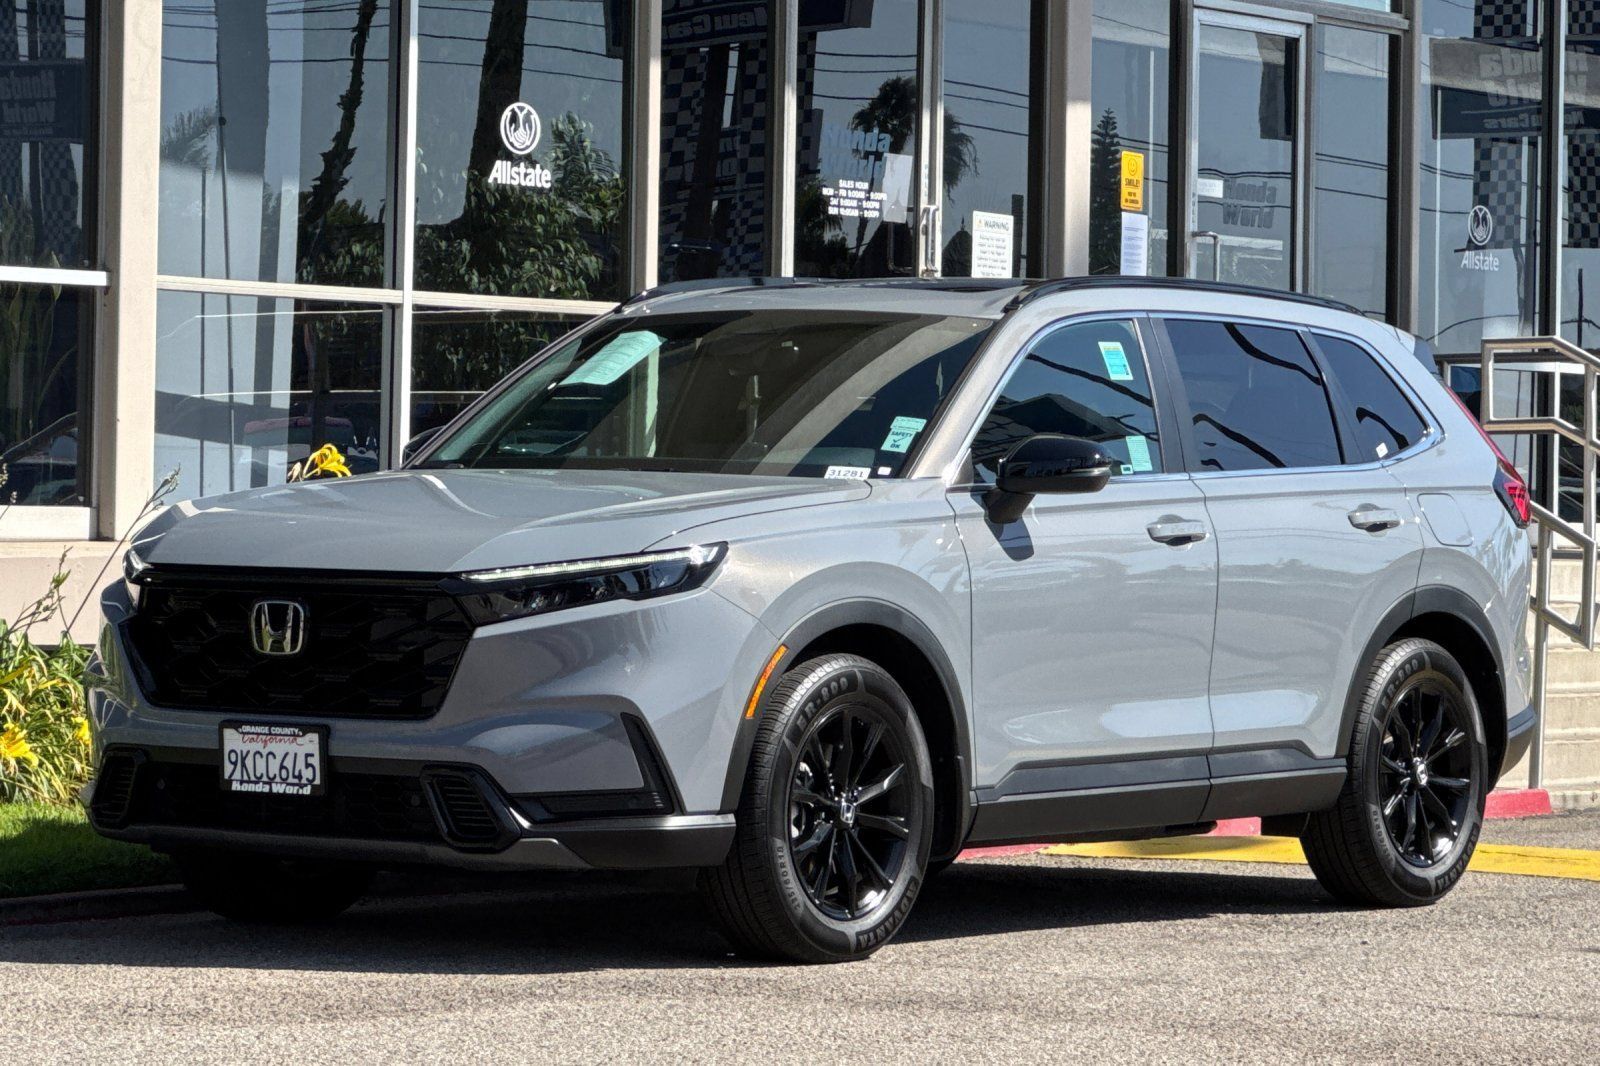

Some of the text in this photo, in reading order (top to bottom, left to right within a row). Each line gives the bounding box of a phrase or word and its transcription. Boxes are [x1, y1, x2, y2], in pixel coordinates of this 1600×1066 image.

[488, 159, 552, 189] Allstate
[1223, 203, 1274, 229] World
[1460, 250, 1500, 271] Allstate
[891, 430, 913, 438] SAFETY
[828, 468, 864, 478] 31281
[241, 725, 299, 736] ORANGE COUNTY
[228, 749, 317, 784] 9KCC645
[231, 780, 270, 793] Honda
